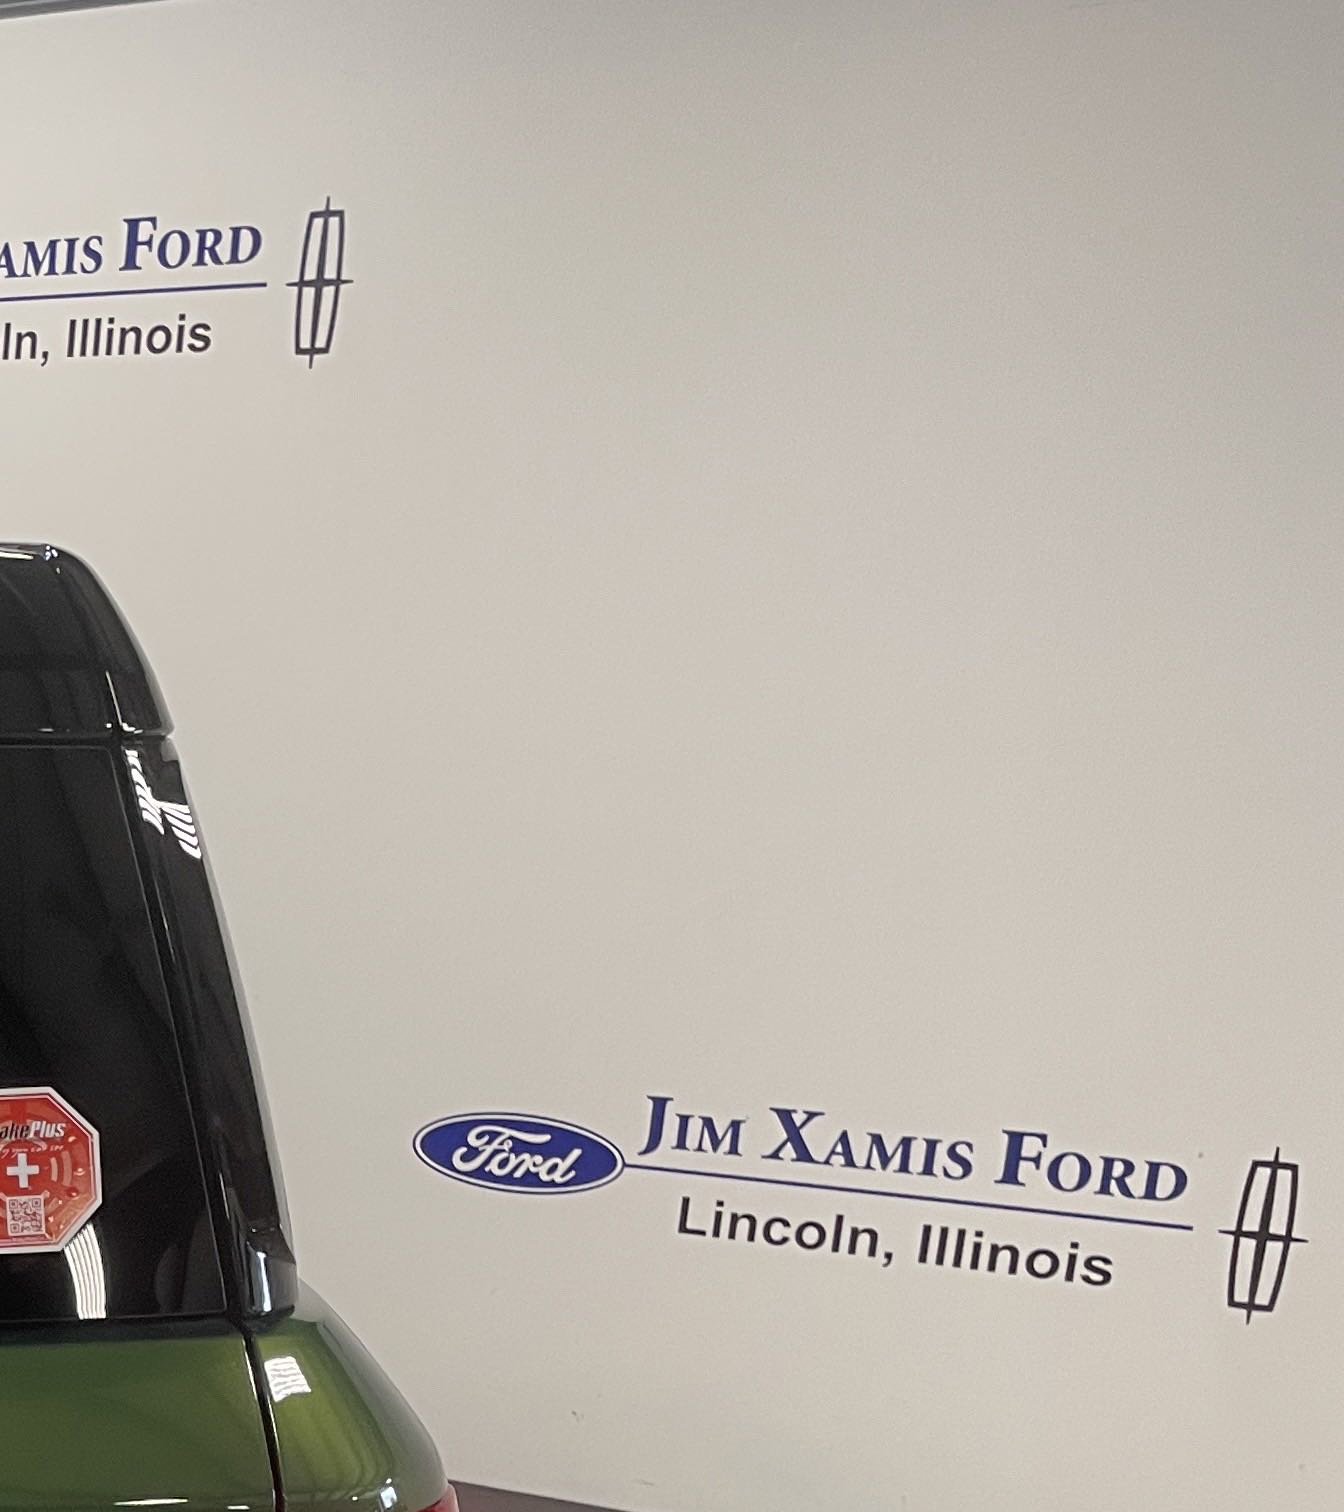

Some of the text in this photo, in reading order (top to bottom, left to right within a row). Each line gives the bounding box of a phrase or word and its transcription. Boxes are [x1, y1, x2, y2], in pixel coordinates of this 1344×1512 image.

[65, 312, 213, 358] Illinois
[450, 1122, 578, 1187] Ford
[675, 1196, 1115, 1288] Lincoln, Illinois
